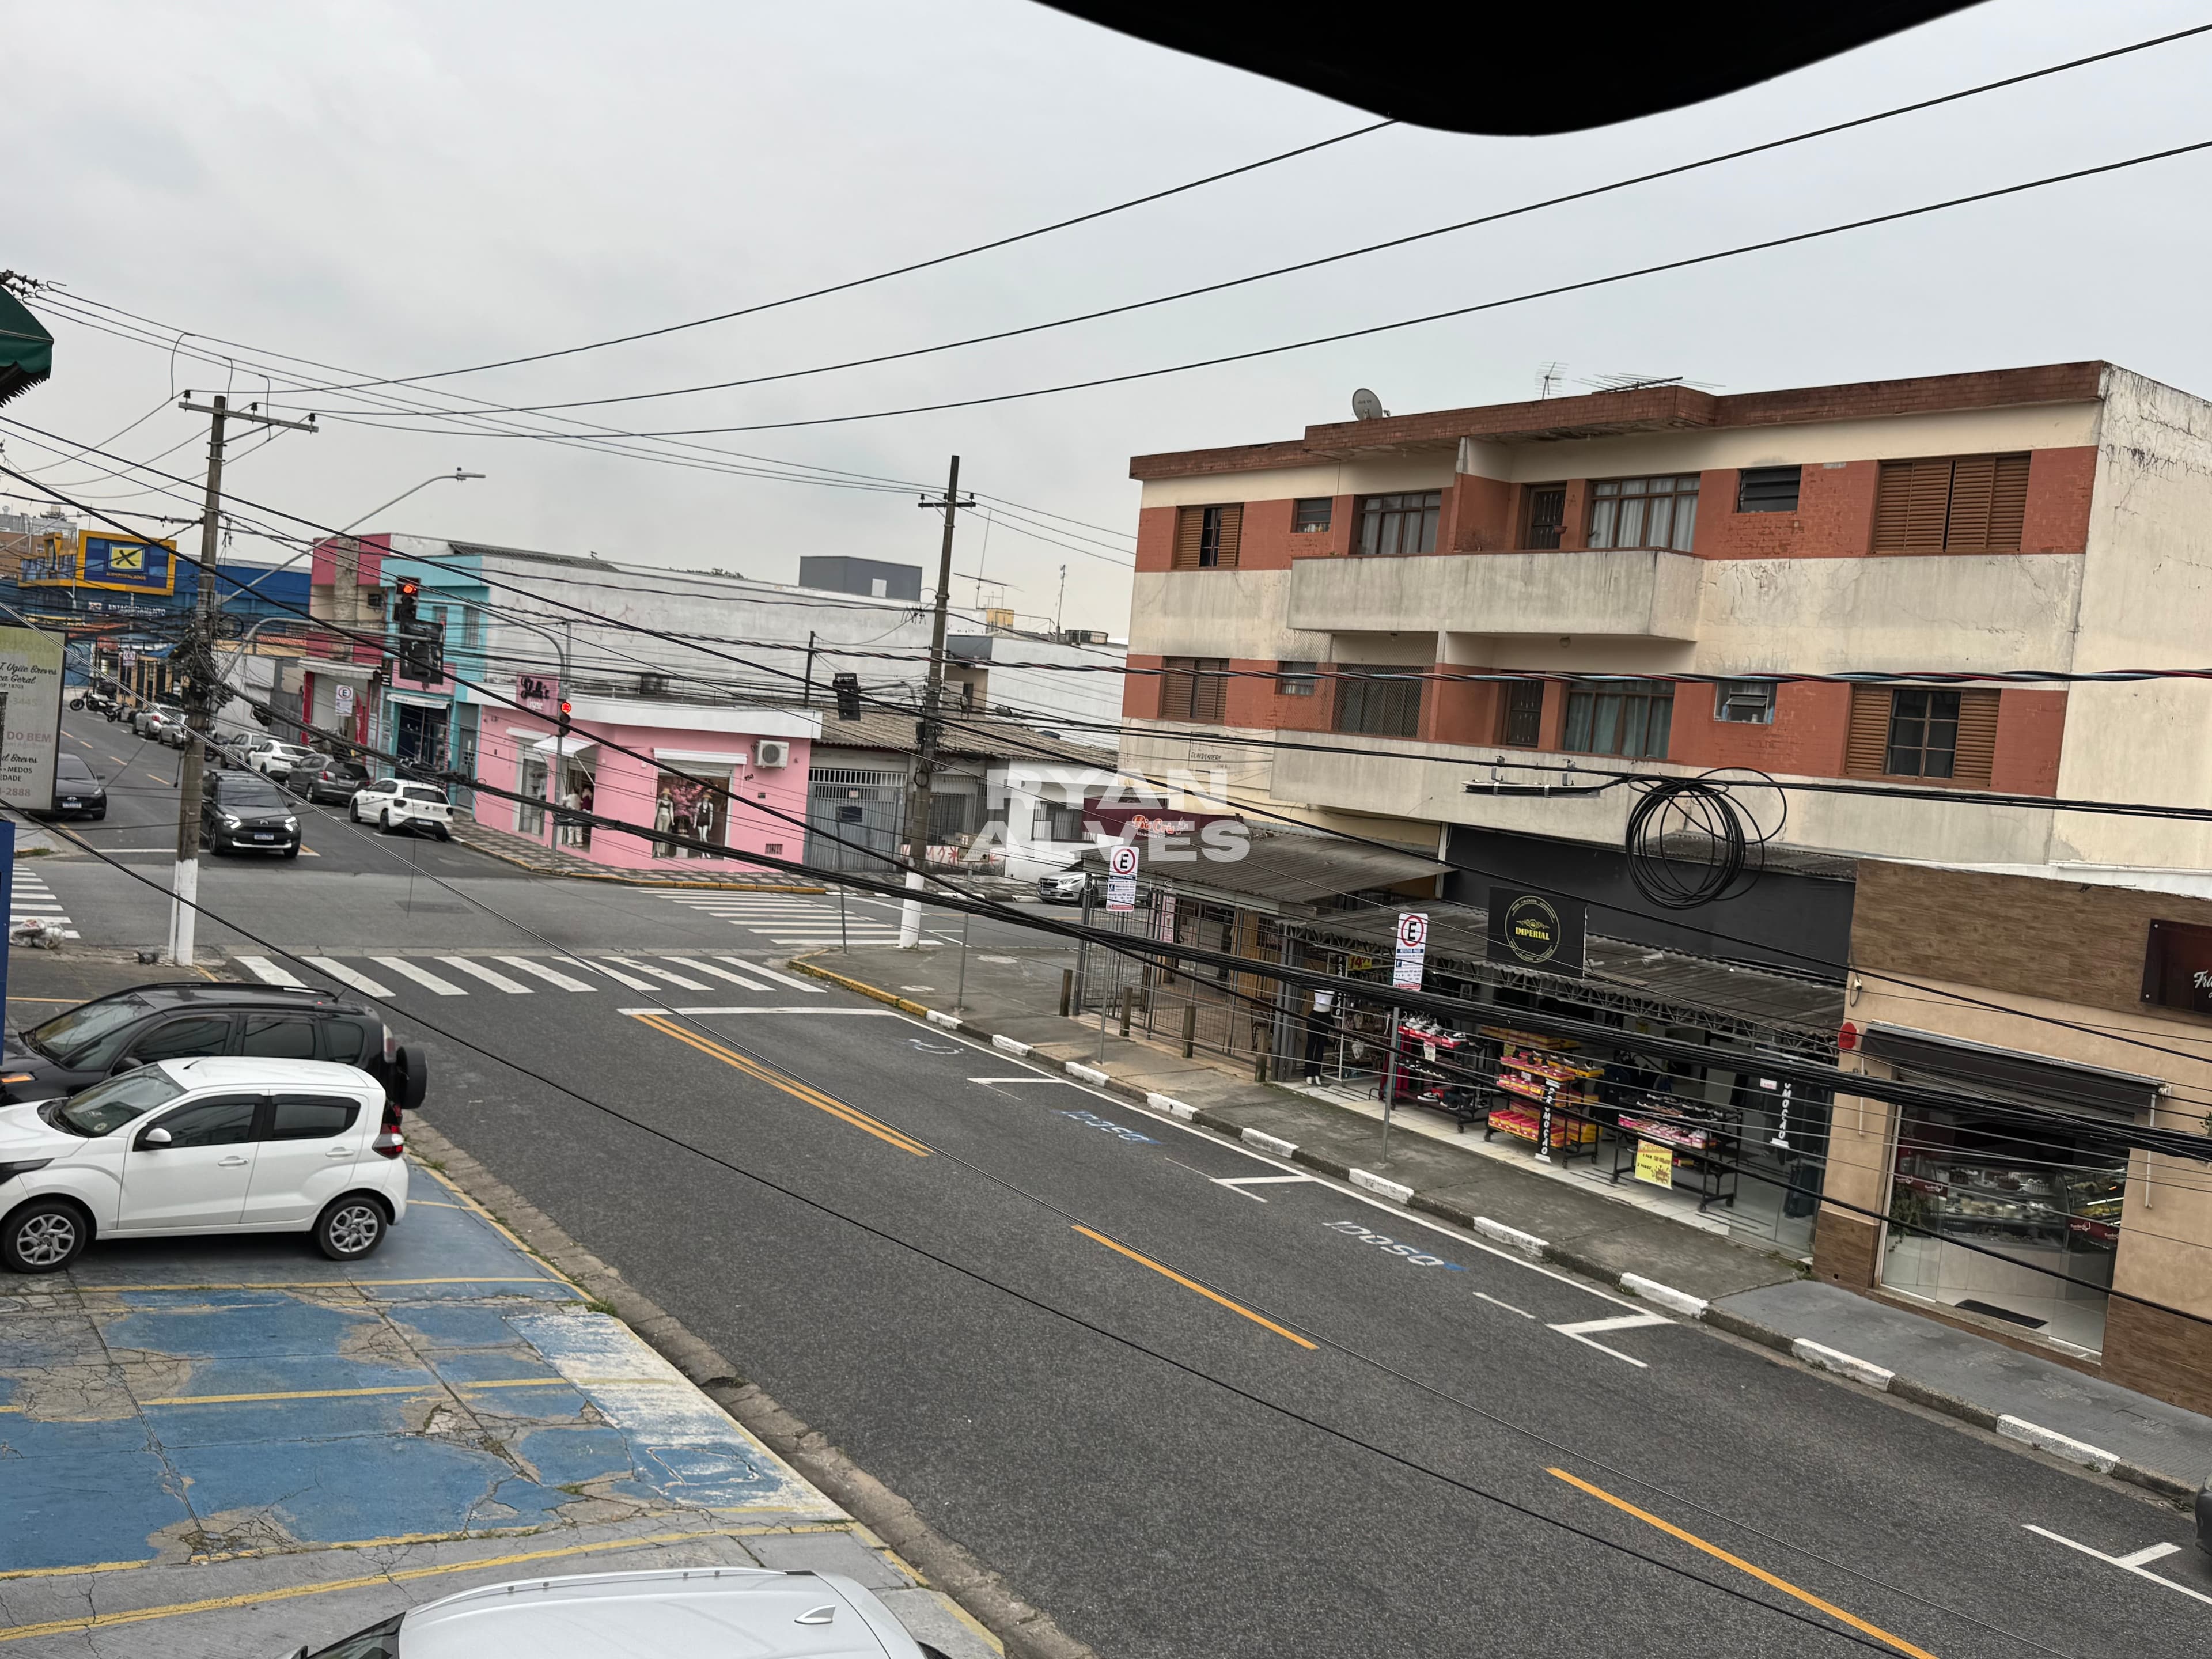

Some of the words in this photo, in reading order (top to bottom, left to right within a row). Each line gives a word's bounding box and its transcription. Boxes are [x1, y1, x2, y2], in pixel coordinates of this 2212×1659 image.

[10, 674, 36, 684] Geral
[343, 689, 347, 697] E
[6, 730, 24, 741] DO
[26, 732, 51, 743] BEM
[1120, 854, 1129, 869] E
[1407, 922, 1417, 940] E
[1515, 926, 1550, 941] IMPERIAL
[1321, 1221, 1445, 1266] IDOSO
